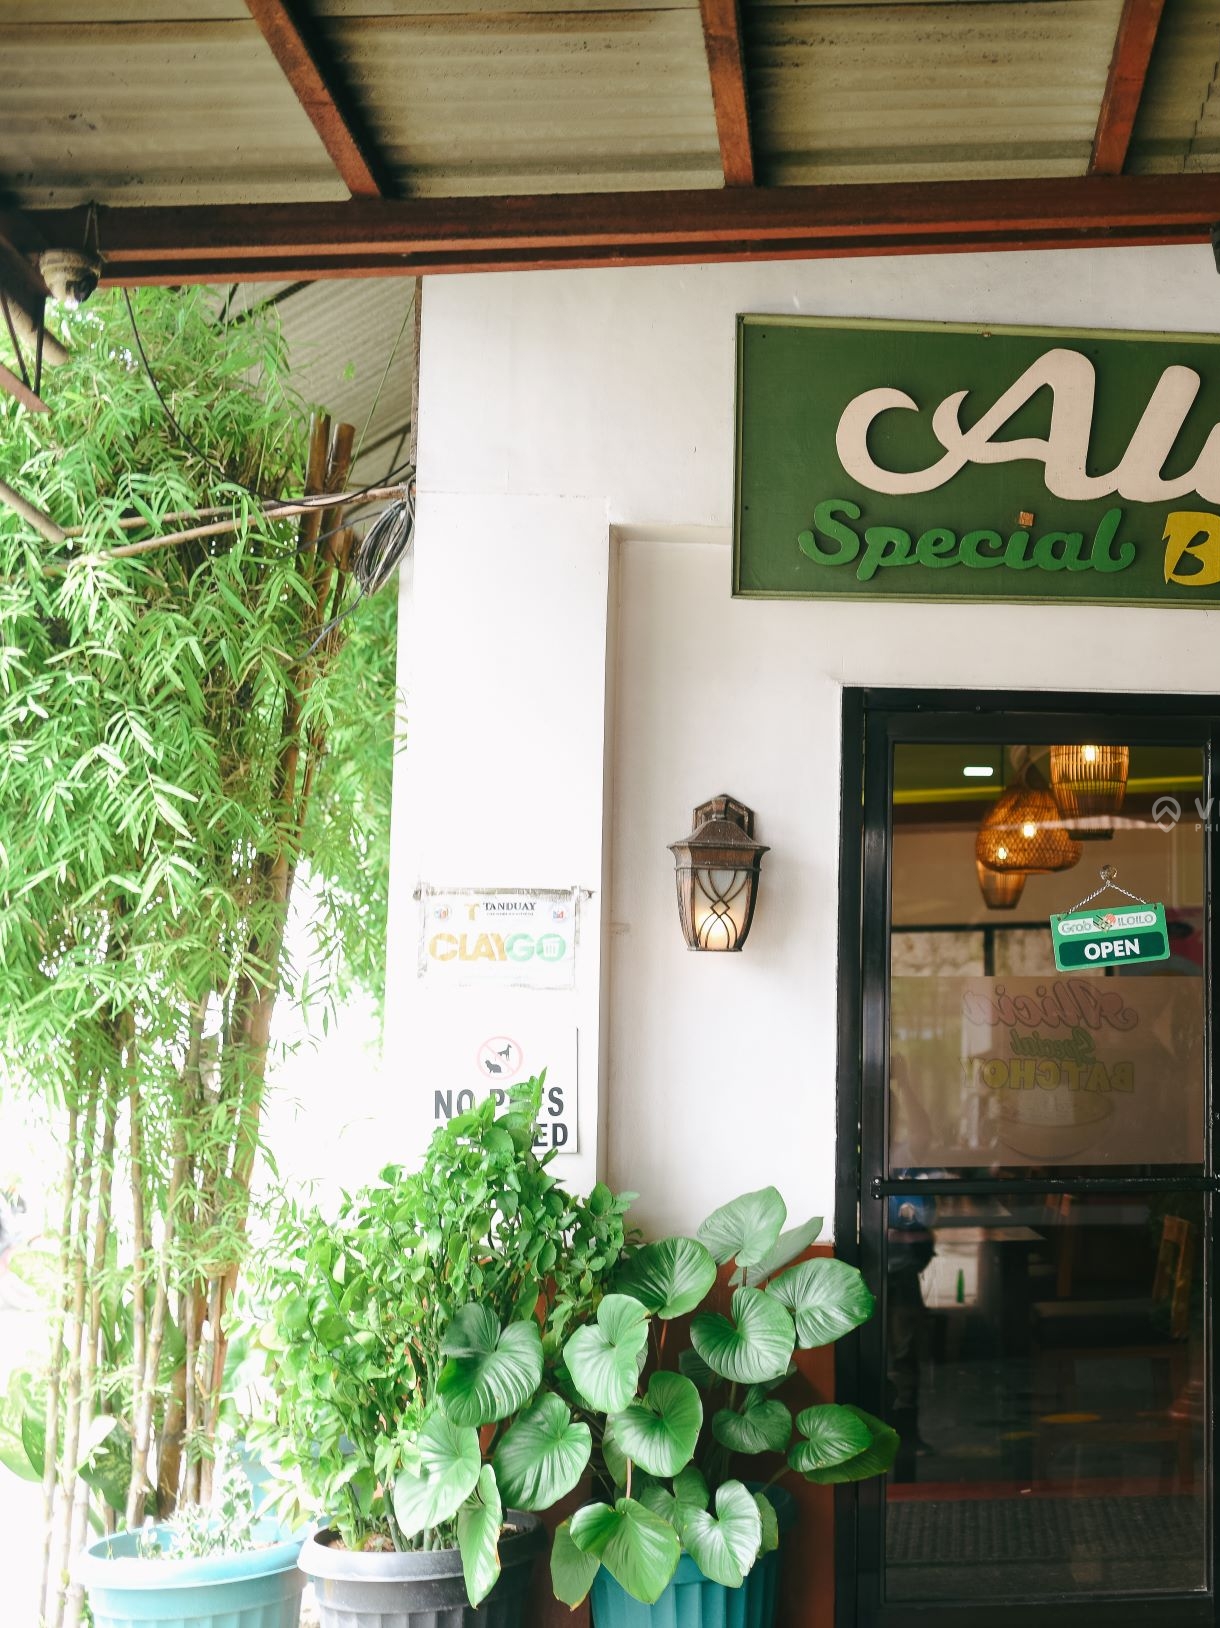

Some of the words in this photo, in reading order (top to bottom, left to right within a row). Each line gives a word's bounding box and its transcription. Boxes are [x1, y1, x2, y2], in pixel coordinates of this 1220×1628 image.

[798, 498, 1136, 581] Special
[482, 901, 537, 912] TANDUAY
[1061, 919, 1092, 934] Grab
[1117, 913, 1154, 927] ILOILO
[1083, 937, 1141, 961] OPEN
[434, 1089, 475, 1119] NO
